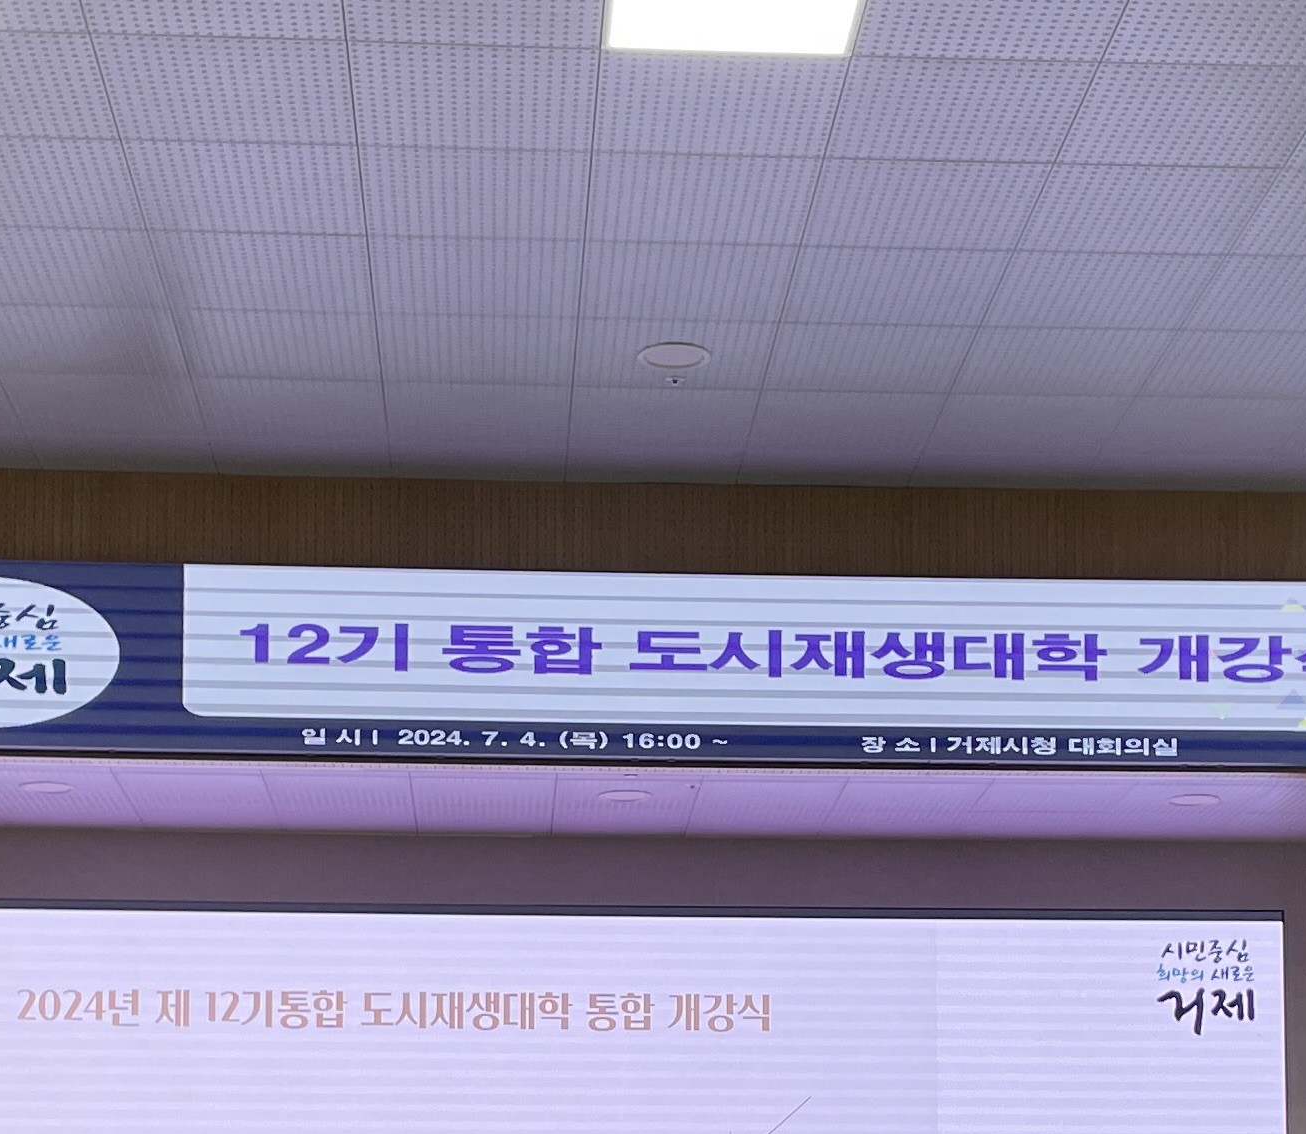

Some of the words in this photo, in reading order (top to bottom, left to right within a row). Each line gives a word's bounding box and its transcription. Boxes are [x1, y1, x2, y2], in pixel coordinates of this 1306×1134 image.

[240, 623, 408, 673] 12기
[441, 623, 603, 676] 통합
[629, 627, 1107, 682] 도시재생대학
[397, 729, 470, 747] 2024.
[481, 730, 507, 747] 7.
[519, 731, 546, 748] 4.
[559, 731, 608, 750] (목)
[622, 733, 701, 750] 16:00
[946, 736, 1057, 756] 거제시청
[1068, 737, 1178, 757] 대회의실
[1161, 939, 1249, 963] 시민중심
[1156, 963, 1204, 983] 희망의
[16, 989, 140, 1027] 2024년
[155, 989, 190, 1027] 제
[205, 989, 348, 1029] 12기통합
[360, 991, 574, 1031] 도시재생대학
[585, 992, 656, 1032] 통합
[667, 993, 771, 1032] 개강식
[1157, 988, 1255, 1035] 거제
